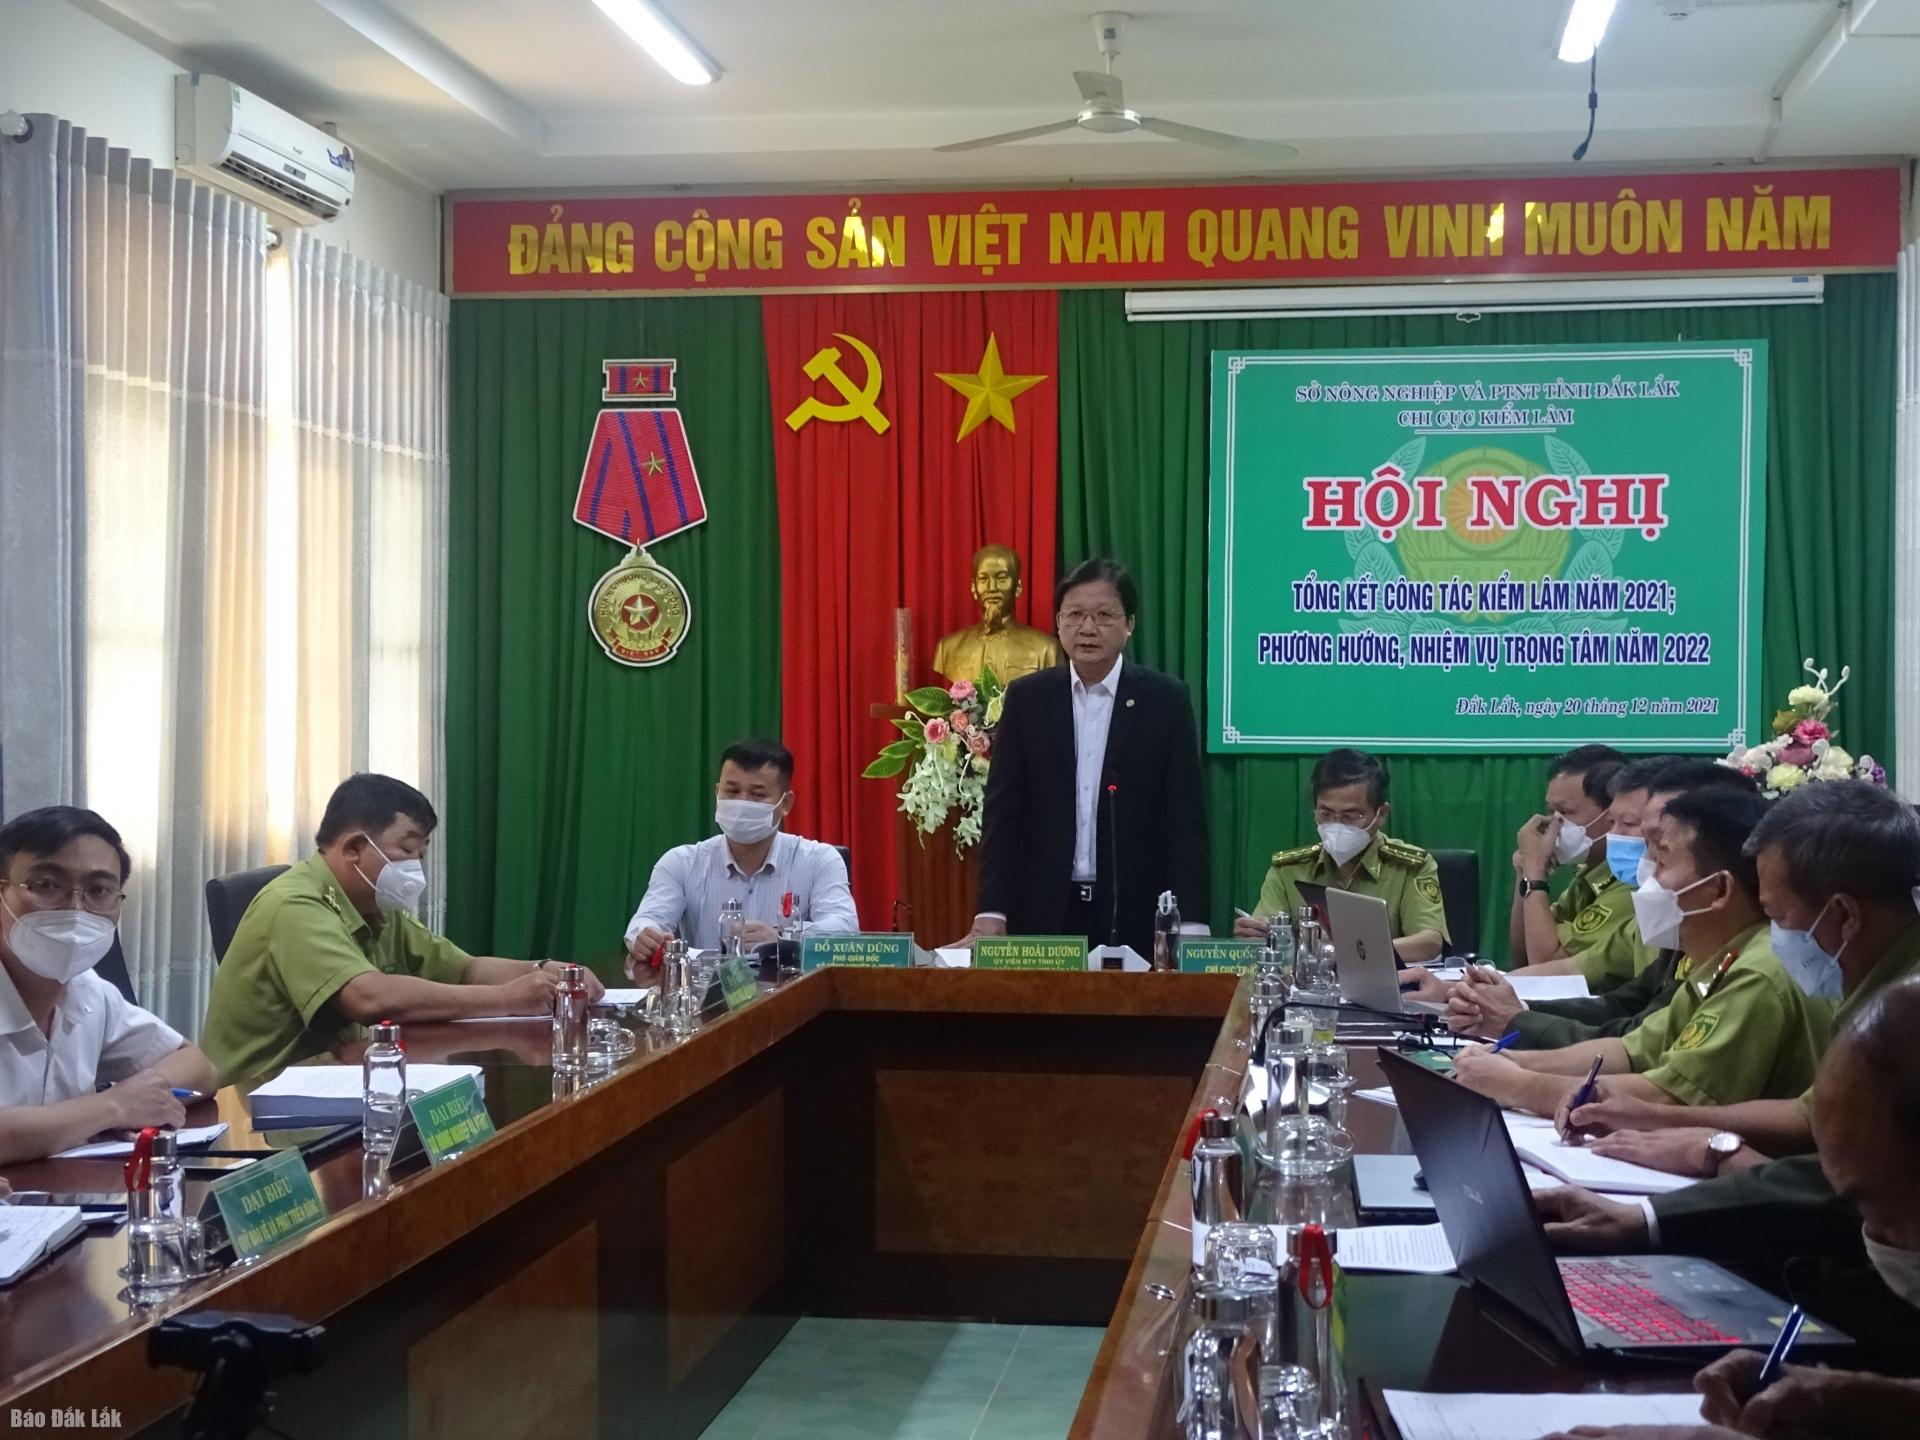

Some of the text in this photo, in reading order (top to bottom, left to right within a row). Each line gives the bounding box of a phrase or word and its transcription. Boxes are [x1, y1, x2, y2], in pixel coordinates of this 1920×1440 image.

[508, 184, 1832, 281] ĐẢNG CỘNG SẢN VIỆT NAM QUANG VINH MUÔN NĂM
[1296, 373, 1680, 404] SỞ NÔNG NGHIỆP VÀ PTNT TỈNH ĐẮK LẮK
[1398, 402, 1574, 429] CHI CỤC KIỂM LÂM
[1304, 464, 1668, 541] HỘI NGHỊ
[1293, 571, 1340, 612] TỔNG
[1345, 573, 1379, 612] KẾT
[1384, 575, 1433, 612] CÔNG
[1438, 576, 1474, 612] TÁC
[1478, 570, 1525, 612] KIỂM
[1530, 575, 1570, 612] LÂM
[1575, 575, 1619, 612] NĂM
[1623, 580, 1676, 614] 2021;
[1259, 627, 1710, 671] PHƯƠNG HƯỚNG, NHIỆM VỤ TRỌNG TÂM NĂM 2022
[1456, 695, 1719, 718] Đắk Lắk, ngày 20 tháng 12 năm 2021
